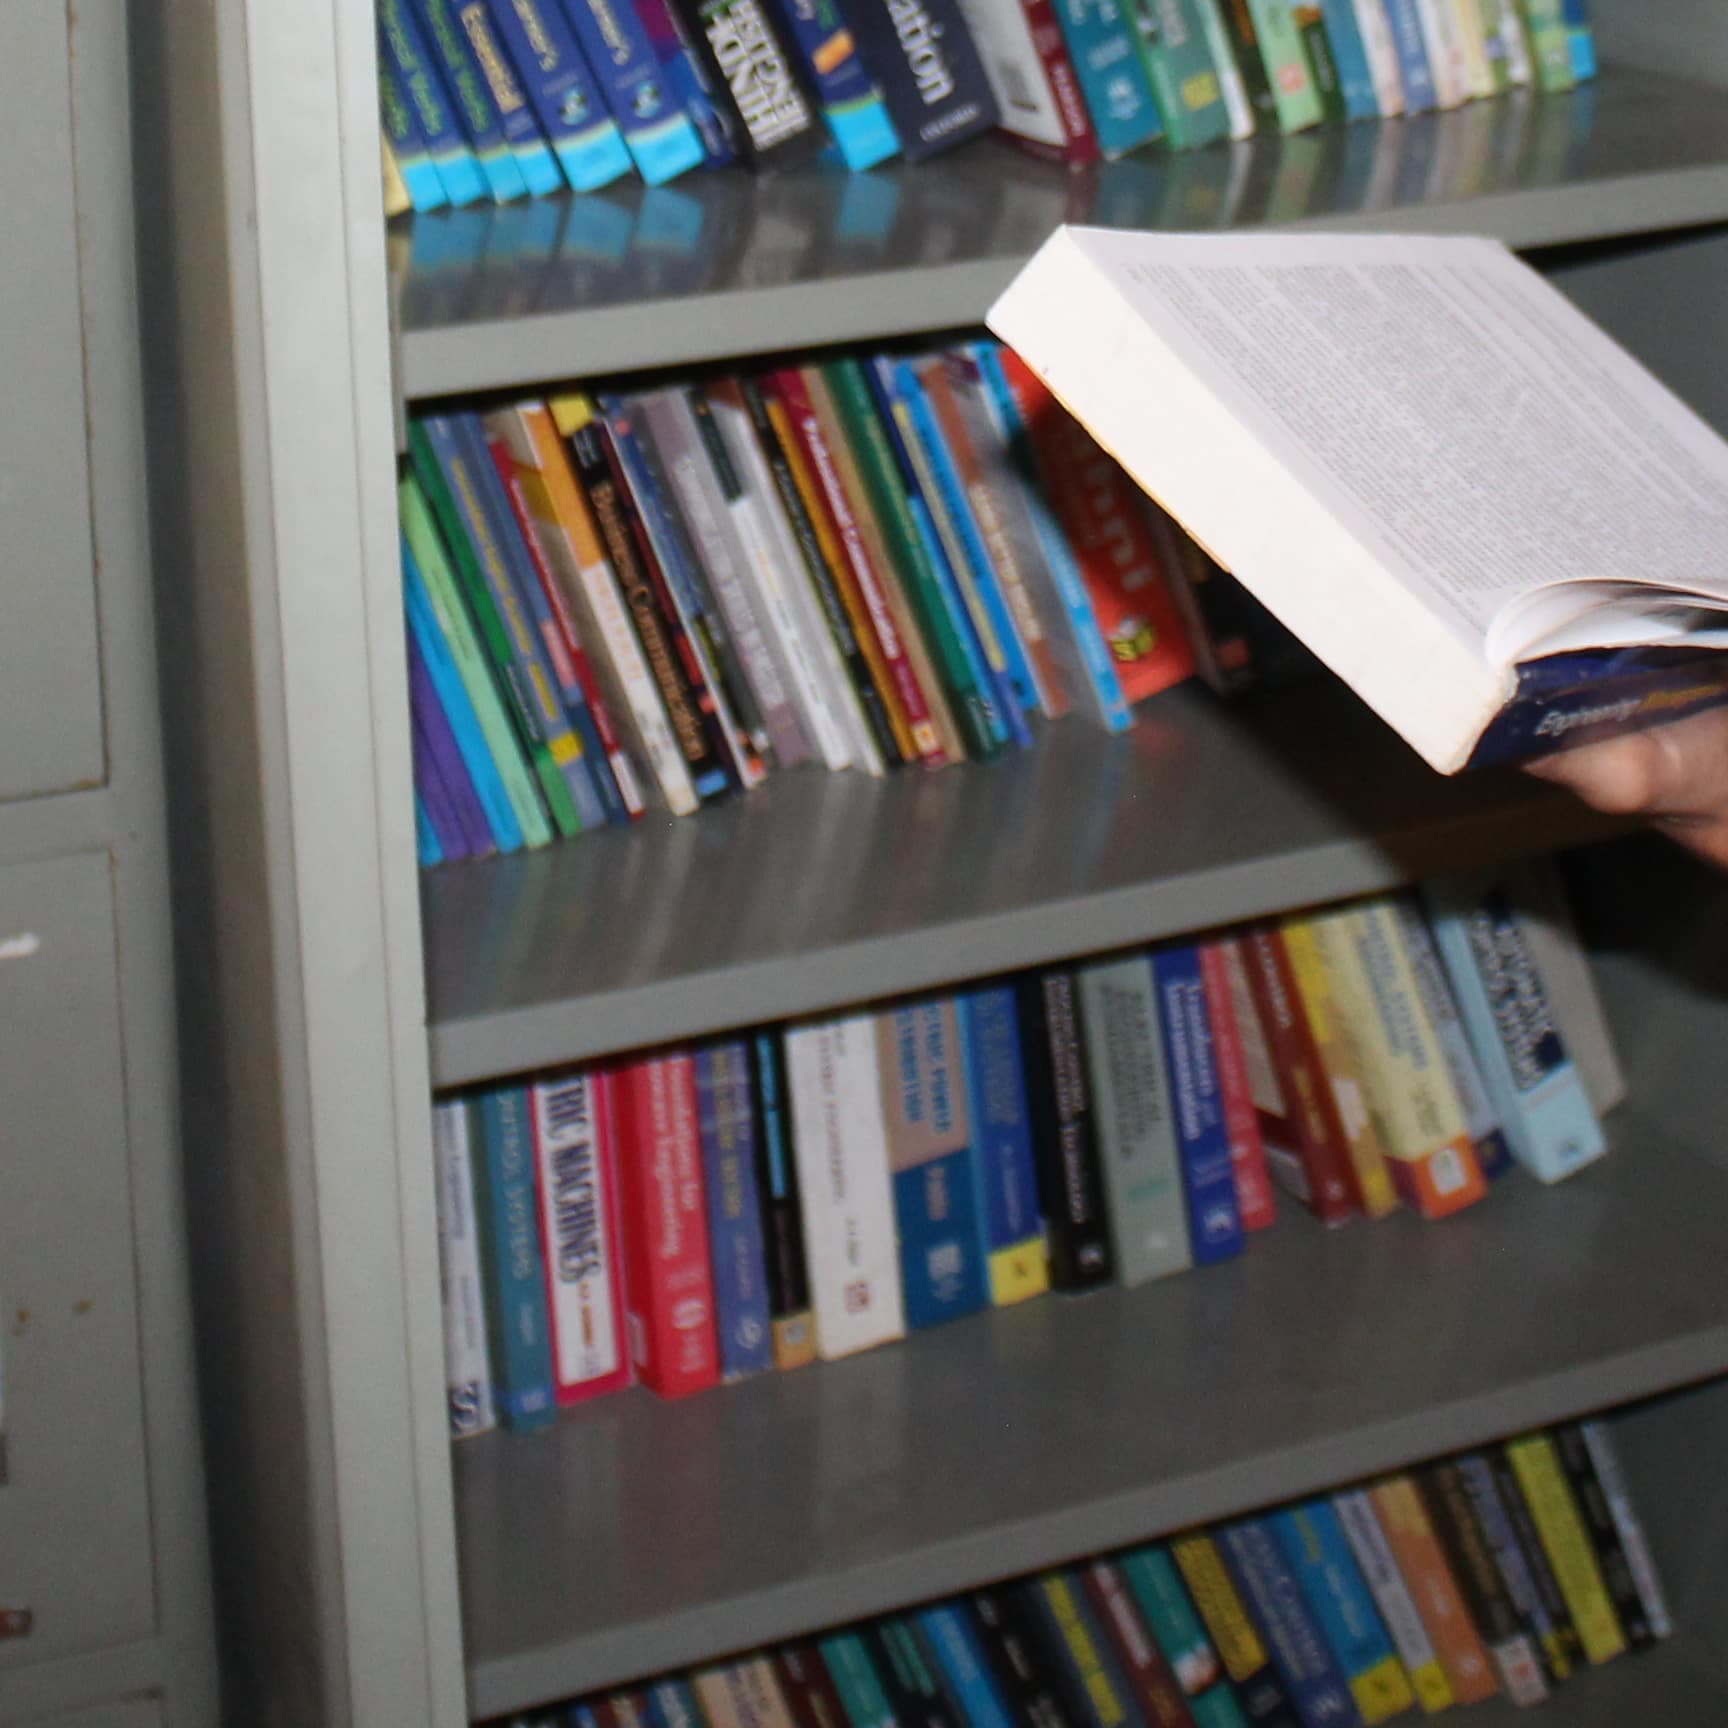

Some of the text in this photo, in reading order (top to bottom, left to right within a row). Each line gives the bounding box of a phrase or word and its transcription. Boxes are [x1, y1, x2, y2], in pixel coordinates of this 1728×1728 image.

[586, 480, 708, 762] Business Communication
[555, 1139, 603, 1284] MACHINES
